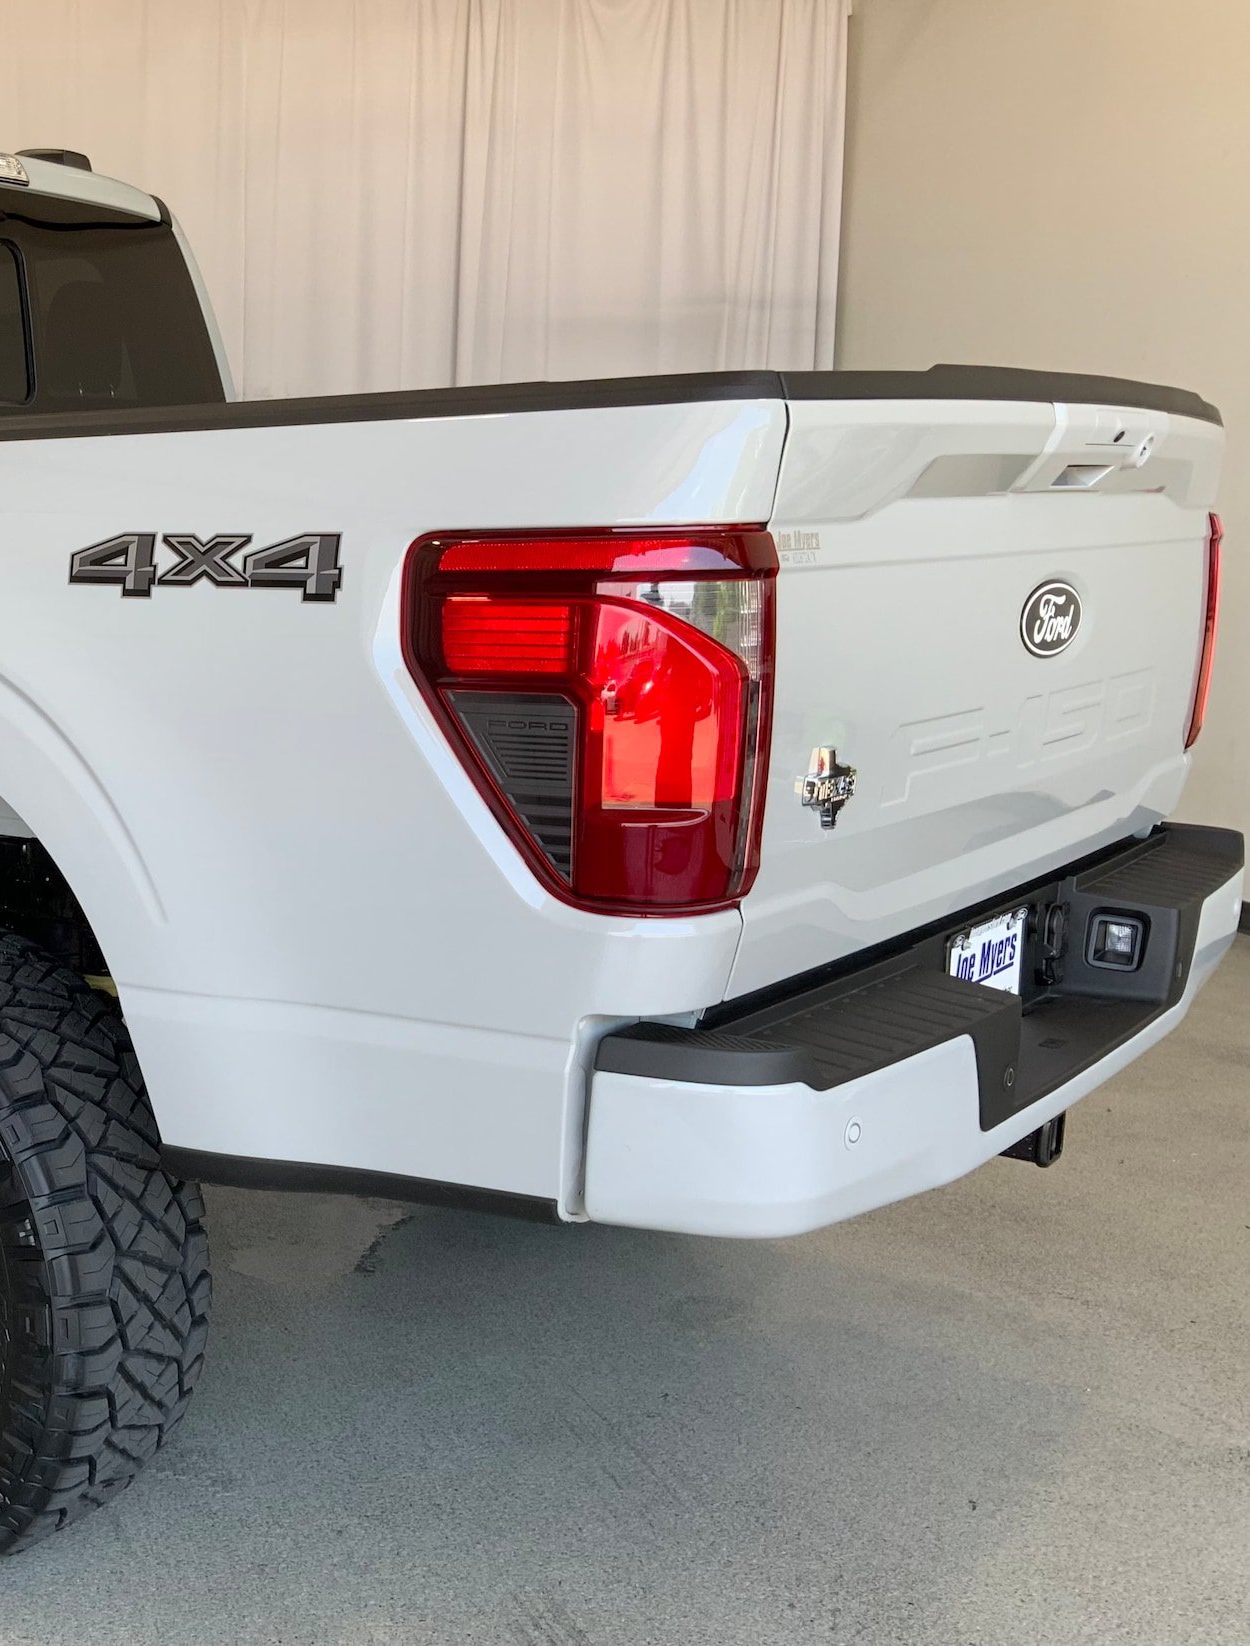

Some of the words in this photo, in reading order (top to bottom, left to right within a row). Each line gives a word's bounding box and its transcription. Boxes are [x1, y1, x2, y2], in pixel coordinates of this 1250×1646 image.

[794, 530, 820, 549] Myers
[1034, 594, 1075, 644] Ford
[487, 720, 569, 731] FORD
[979, 933, 1018, 977] Myers
